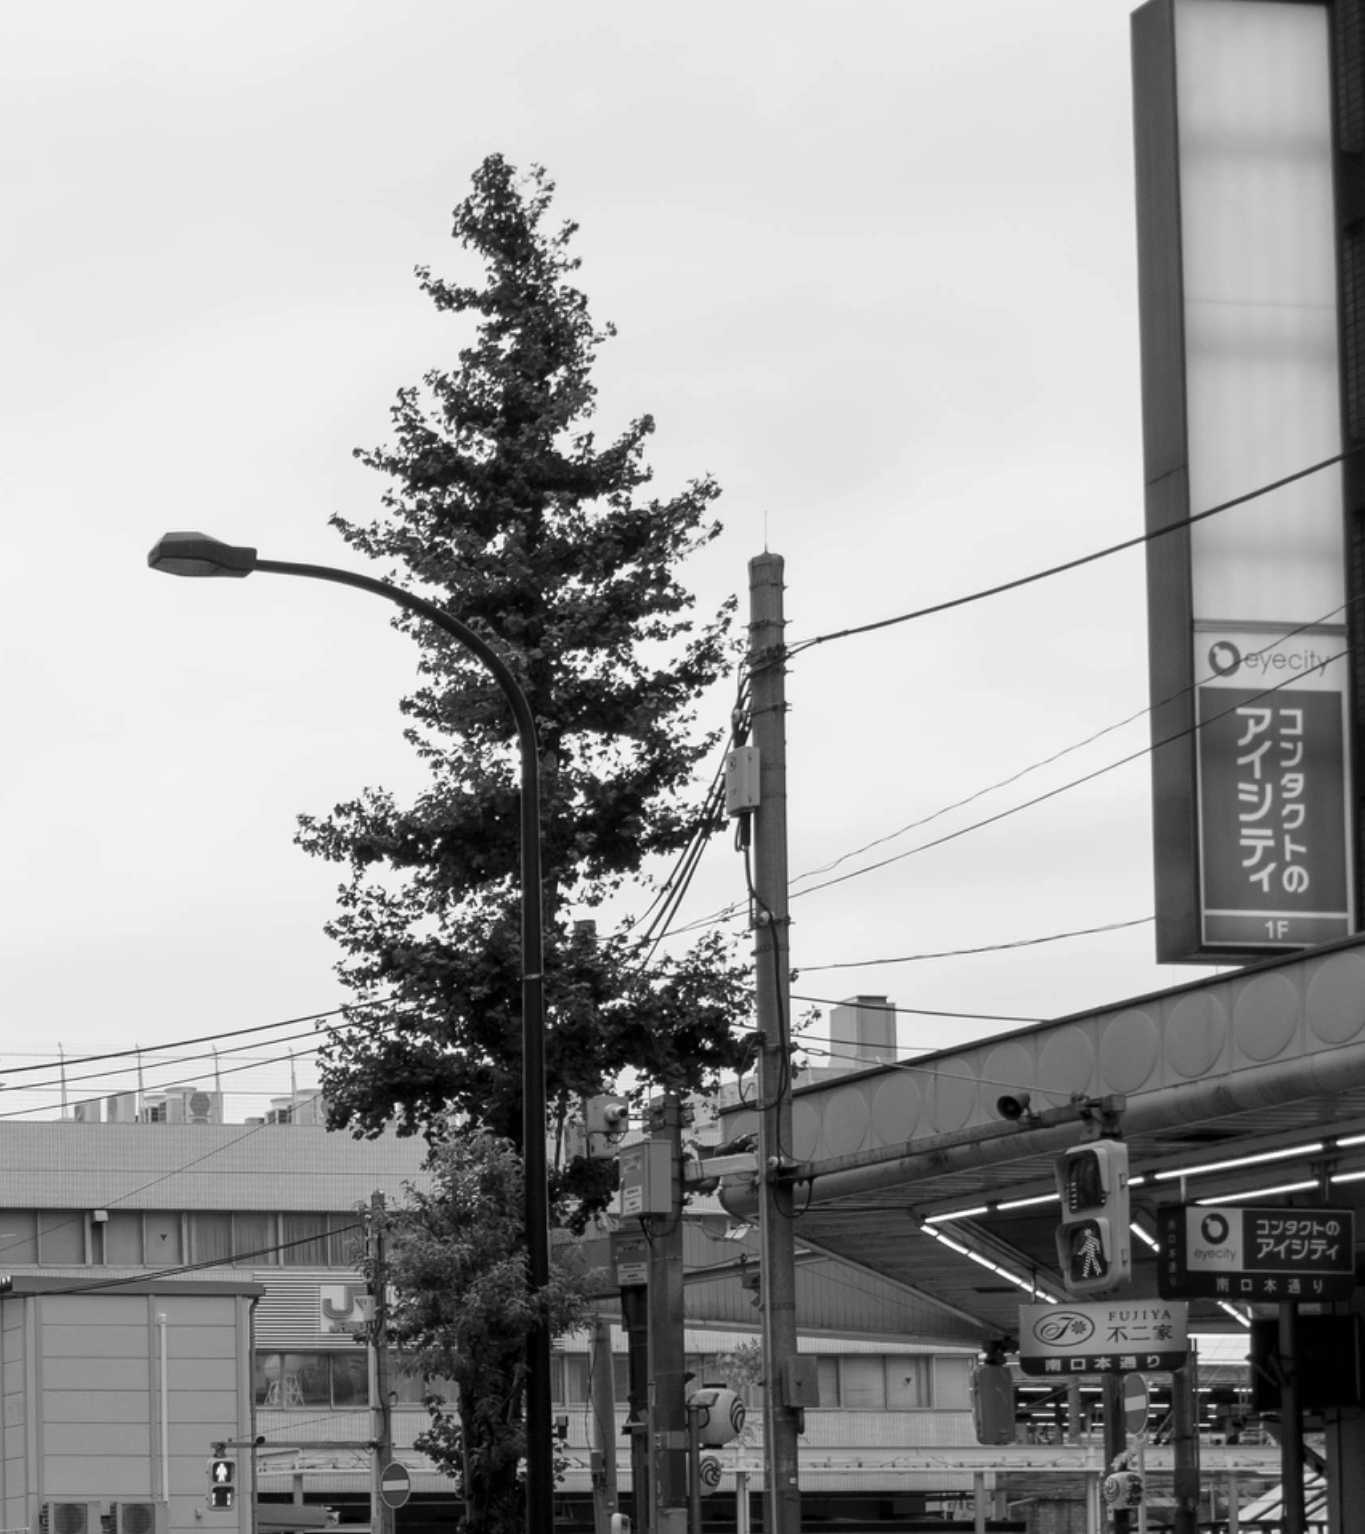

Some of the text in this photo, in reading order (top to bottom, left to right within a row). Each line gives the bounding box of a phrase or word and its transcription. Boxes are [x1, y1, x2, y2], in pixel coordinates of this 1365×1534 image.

[1244, 650, 1330, 677] eyecity
[1236, 707, 1277, 893] アイシティ
[1279, 708, 1310, 893] コンタクトの
[1264, 920, 1289, 940] 1F
[1256, 1219, 1340, 1236] コンタクトの
[1193, 1248, 1237, 1261] eyecity
[1256, 1238, 1339, 1260] アイシティ
[1215, 1278, 1323, 1294] 南口本通り
[1108, 1309, 1172, 1322] FUJIYA
[1106, 1323, 1173, 1343] 不二家
[1045, 1355, 1161, 1372] 南口本通り
